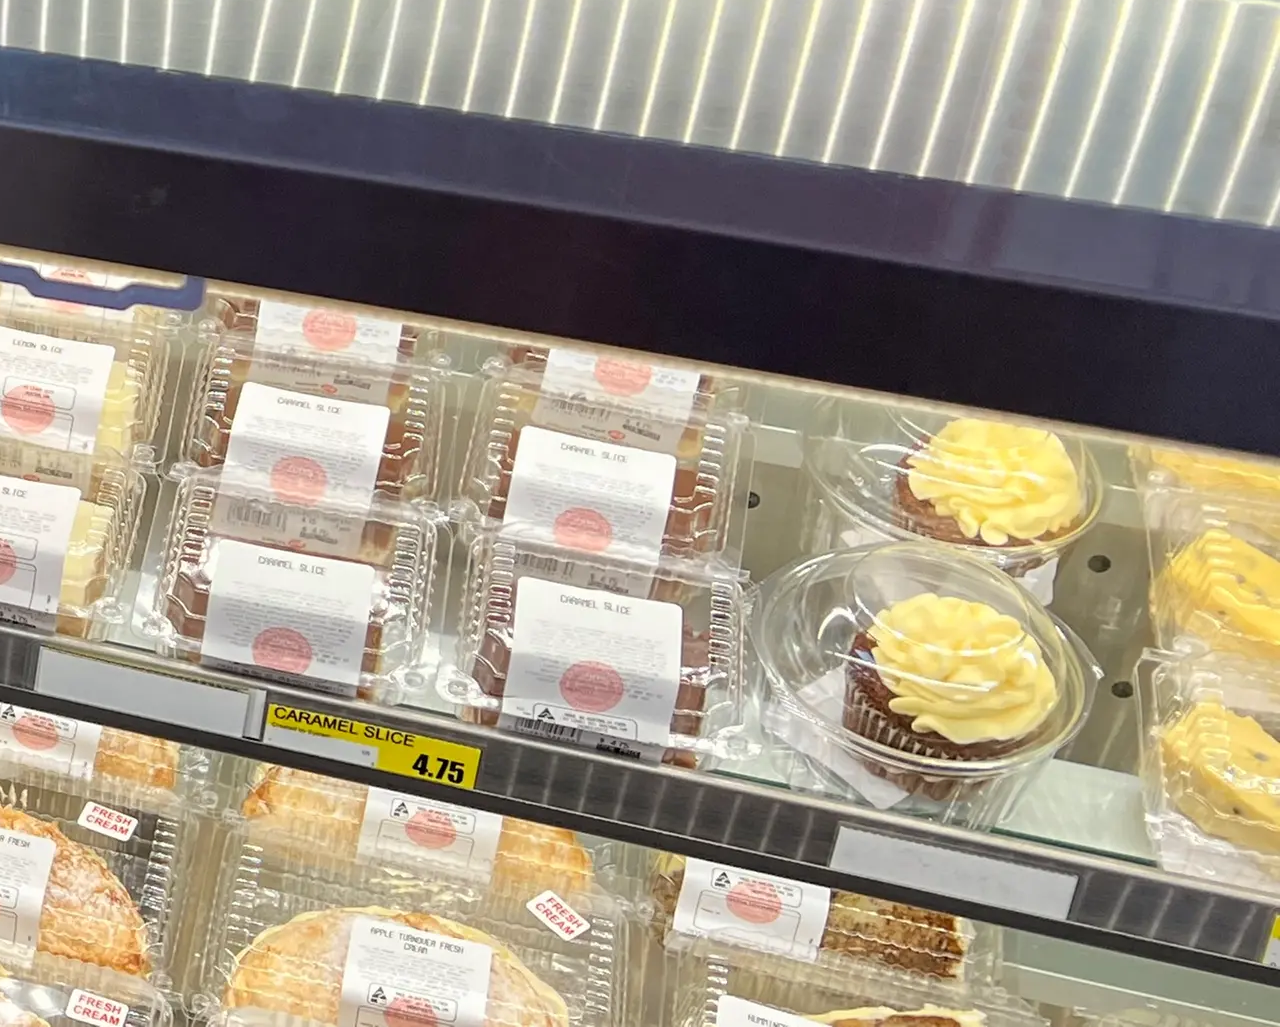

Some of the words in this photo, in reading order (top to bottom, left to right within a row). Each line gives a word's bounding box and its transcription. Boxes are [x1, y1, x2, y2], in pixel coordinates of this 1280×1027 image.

[13, 339, 36, 350] LEMON
[40, 344, 63, 355] SLICE
[560, 442, 597, 458] CARAMEL
[602, 451, 629, 464] SLICE
[2, 487, 28, 499] SLICE
[258, 556, 295, 571] CARAMEL
[300, 563, 327, 576] SLICE
[560, 594, 598, 611] CARAMEL
[604, 602, 631, 616] SLICE
[274, 707, 358, 735] CARAMEL
[364, 726, 416, 748] SLICE
[412, 754, 465, 784] 4.75
[86, 813, 130, 836] CREAM
[92, 805, 133, 827] FRESH
[7, 834, 30, 848] FRESH
[535, 902, 576, 937] CREAM
[547, 896, 584, 930] FRESH
[371, 927, 396, 940] APPLE
[398, 932, 436, 949] TURNOVER
[440, 941, 464, 955] FRESH
[404, 943, 428, 955] CREAM
[73, 1002, 121, 1026] CREAM
[78, 993, 123, 1015] FRESH
